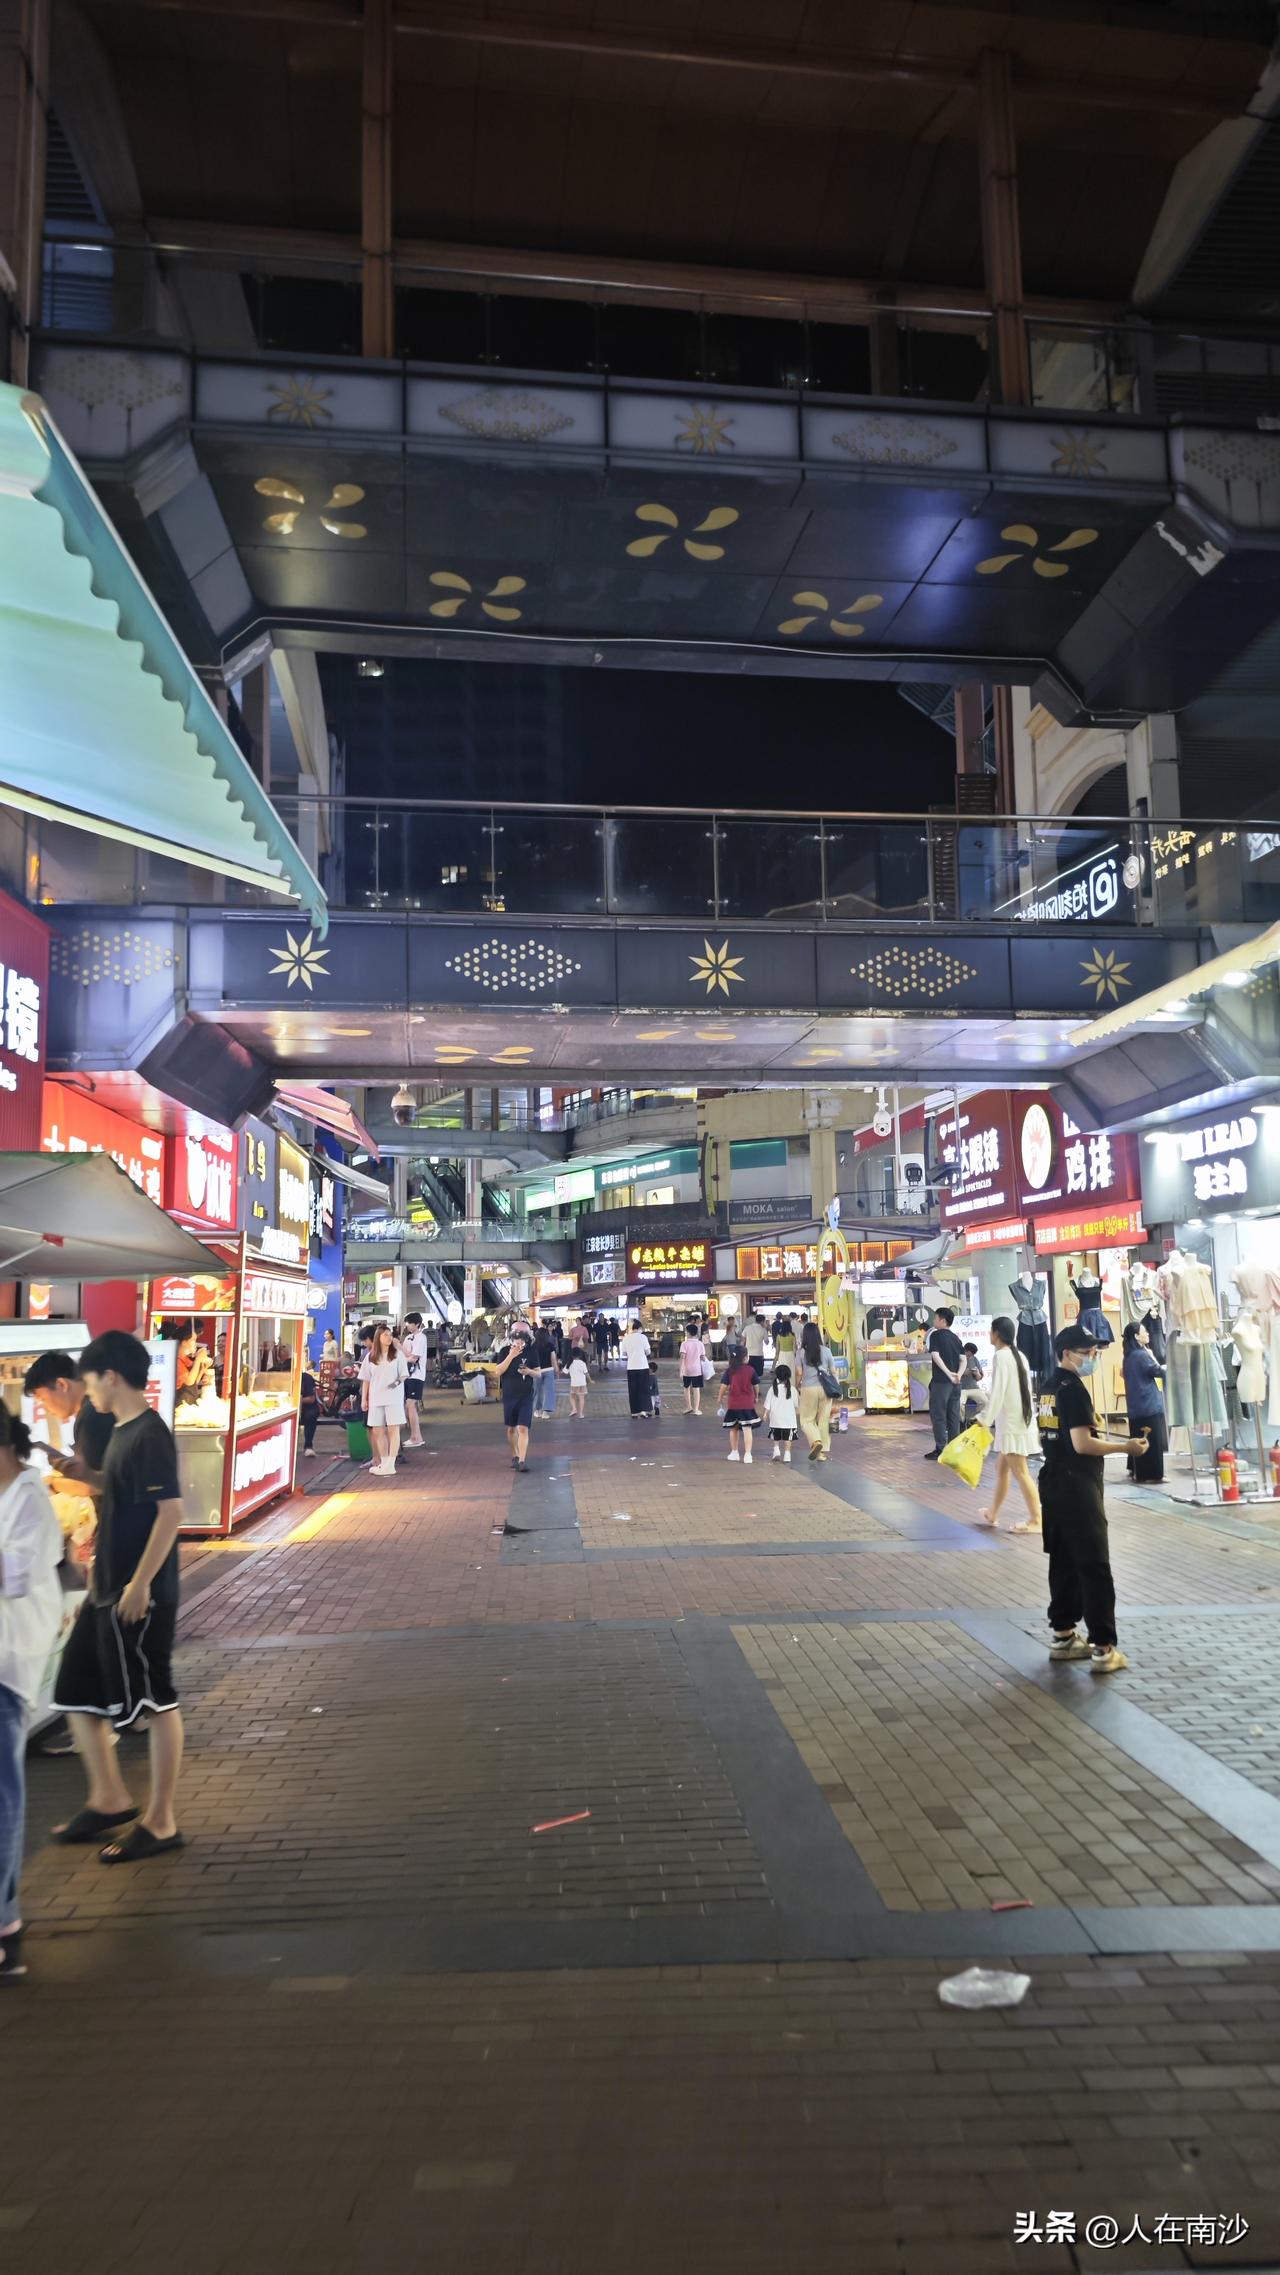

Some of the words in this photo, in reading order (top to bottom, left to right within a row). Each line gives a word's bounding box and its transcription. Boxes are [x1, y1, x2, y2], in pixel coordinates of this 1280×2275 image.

[0, 962, 40, 1063] 镜
[1064, 1135, 1112, 1194] 鸡排
[743, 1203, 774, 1214] MOKA
